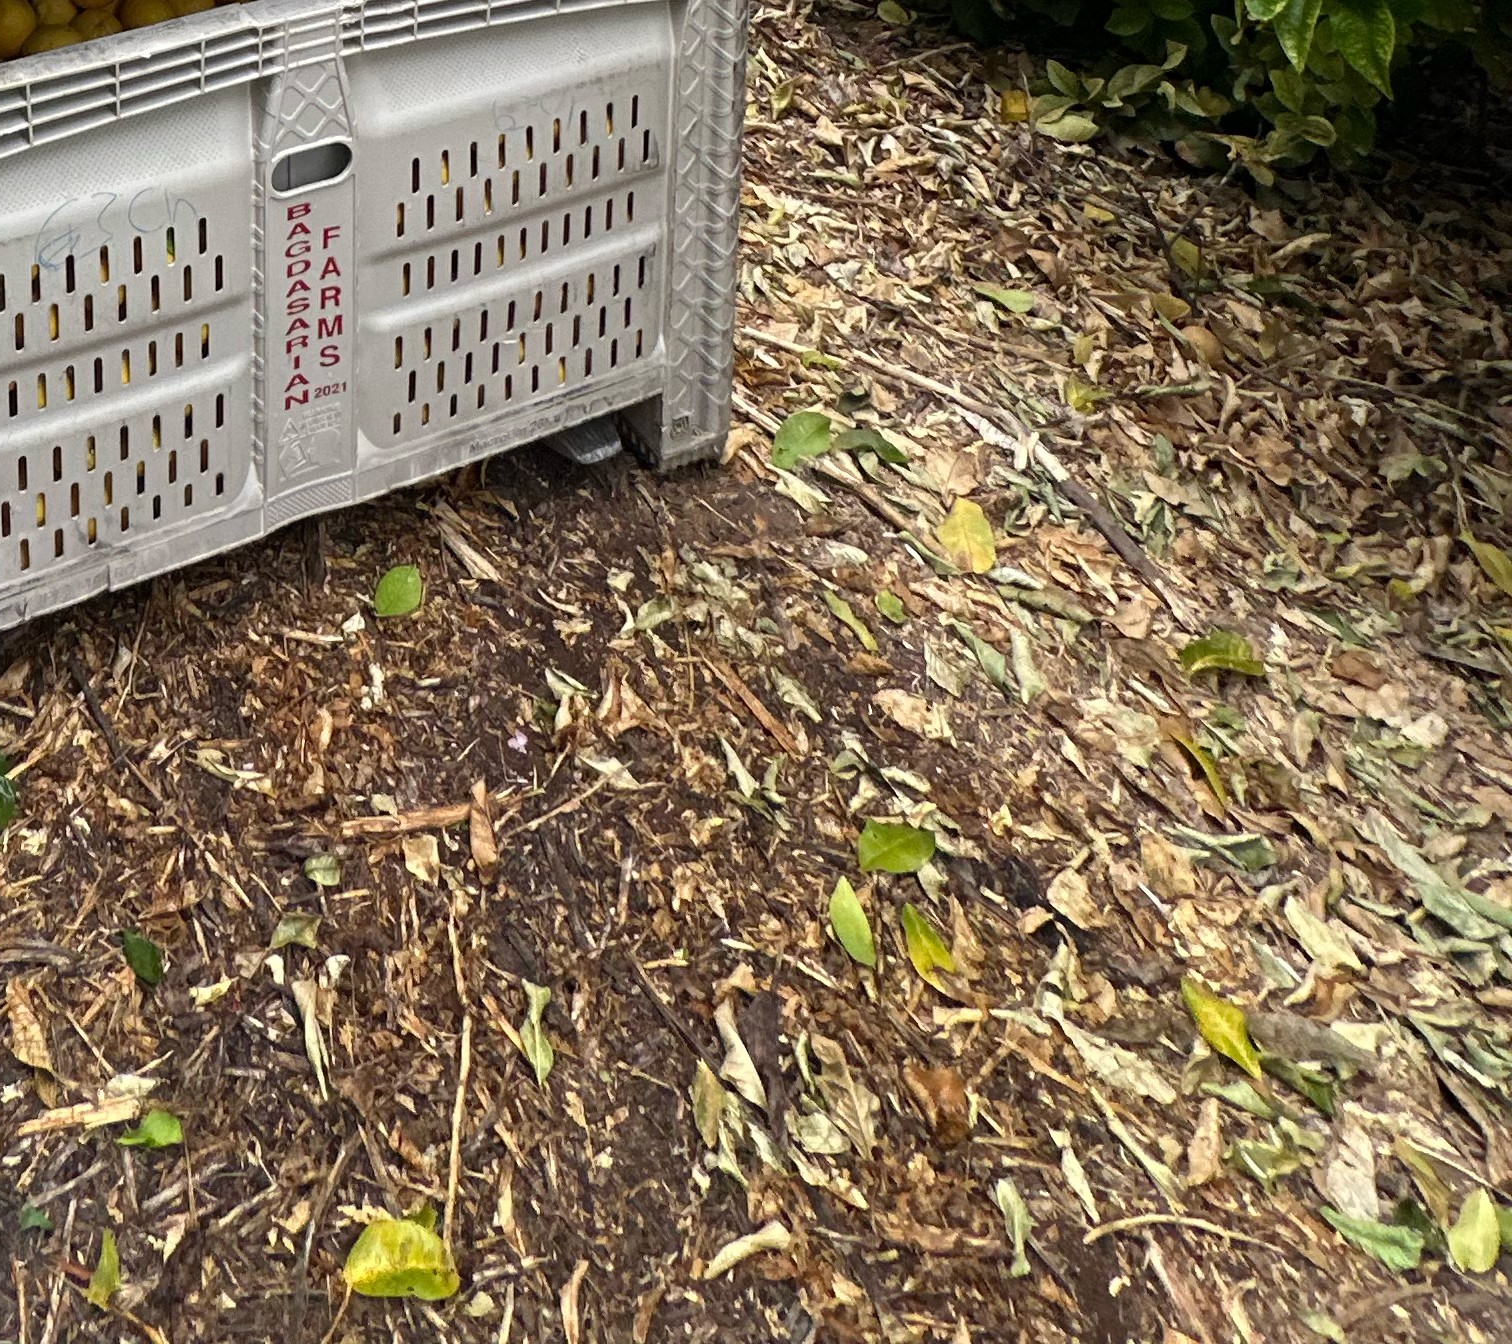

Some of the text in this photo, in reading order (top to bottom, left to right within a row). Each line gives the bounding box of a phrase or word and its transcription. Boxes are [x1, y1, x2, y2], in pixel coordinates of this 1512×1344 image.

[284, 202, 312, 411] BAGDASARIAN
[317, 226, 344, 367] FARMS
[314, 381, 348, 399] 2021
